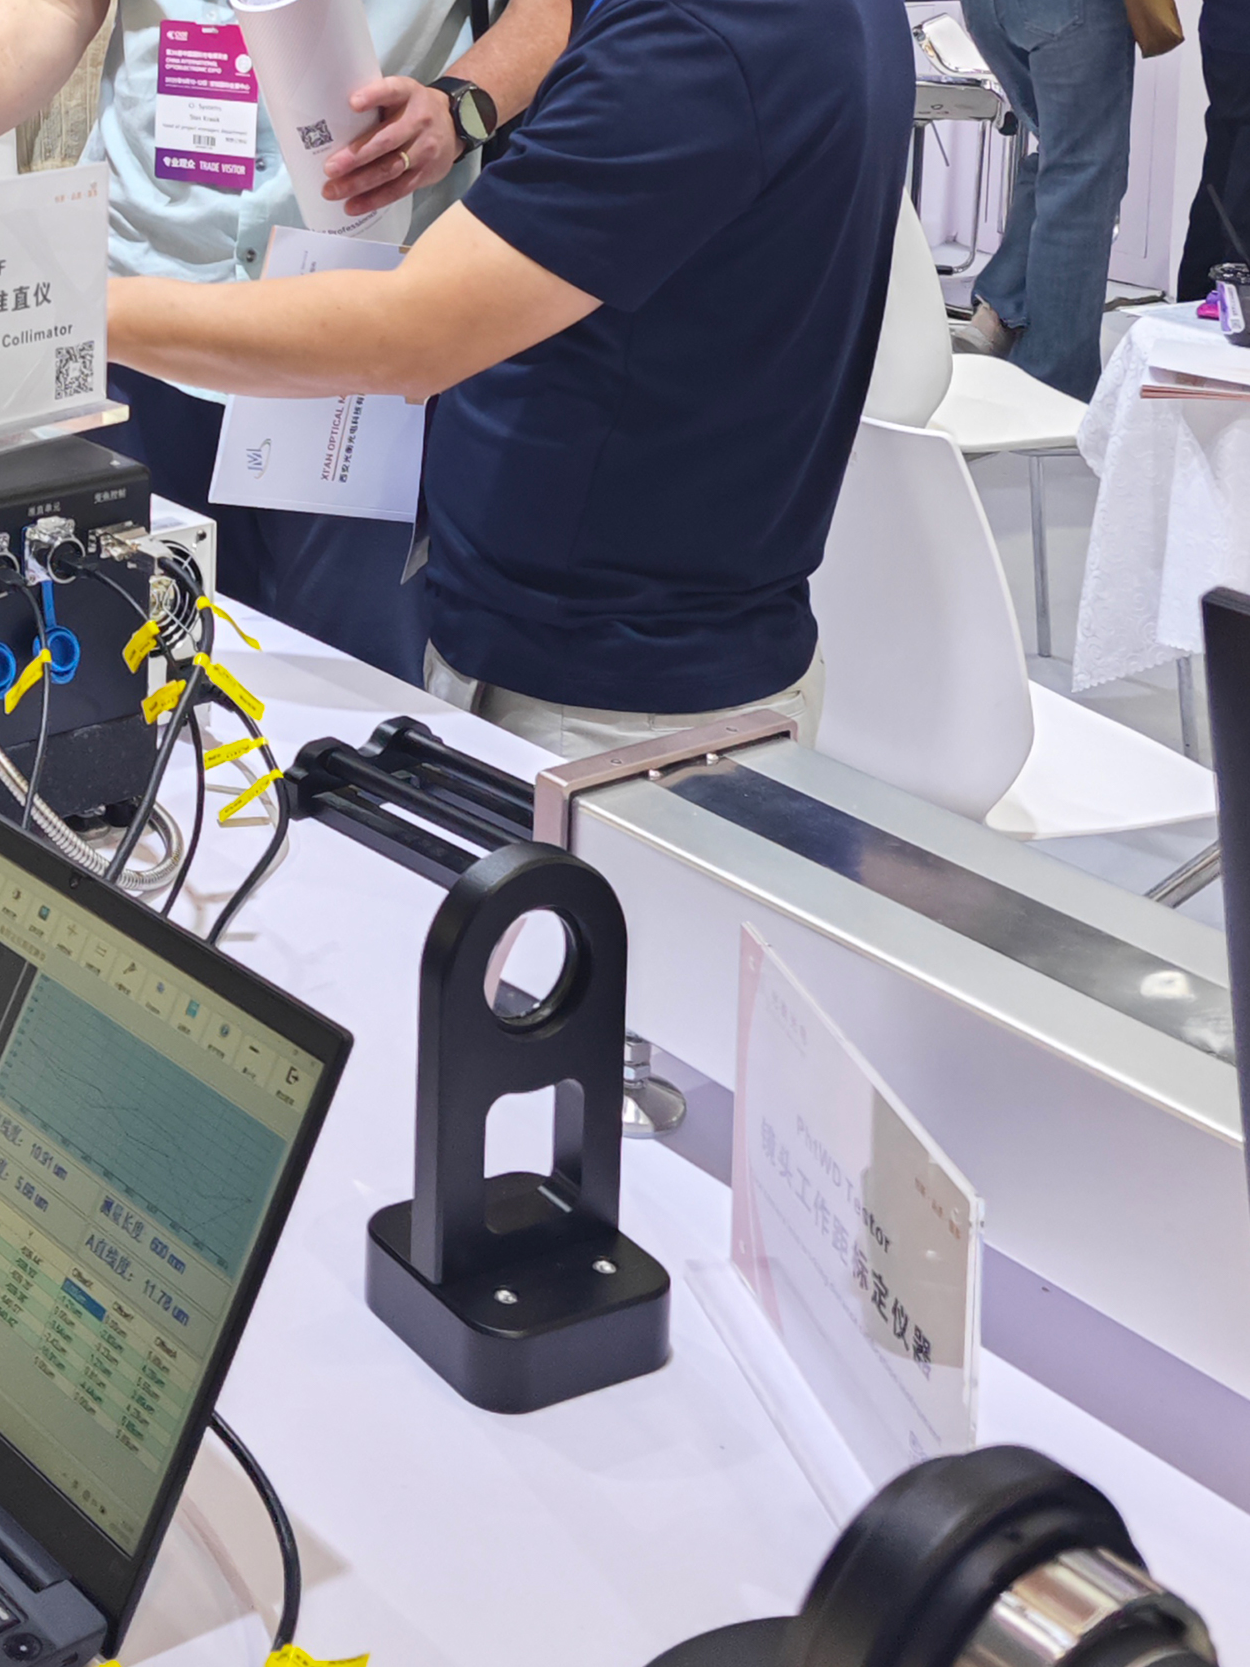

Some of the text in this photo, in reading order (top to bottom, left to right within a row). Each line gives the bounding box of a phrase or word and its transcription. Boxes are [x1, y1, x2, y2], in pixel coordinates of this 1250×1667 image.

[1, 323, 74, 349] Collimator
[326, 406, 345, 452] OPTICAL
[338, 393, 366, 484] 西安光衡光电科技有
